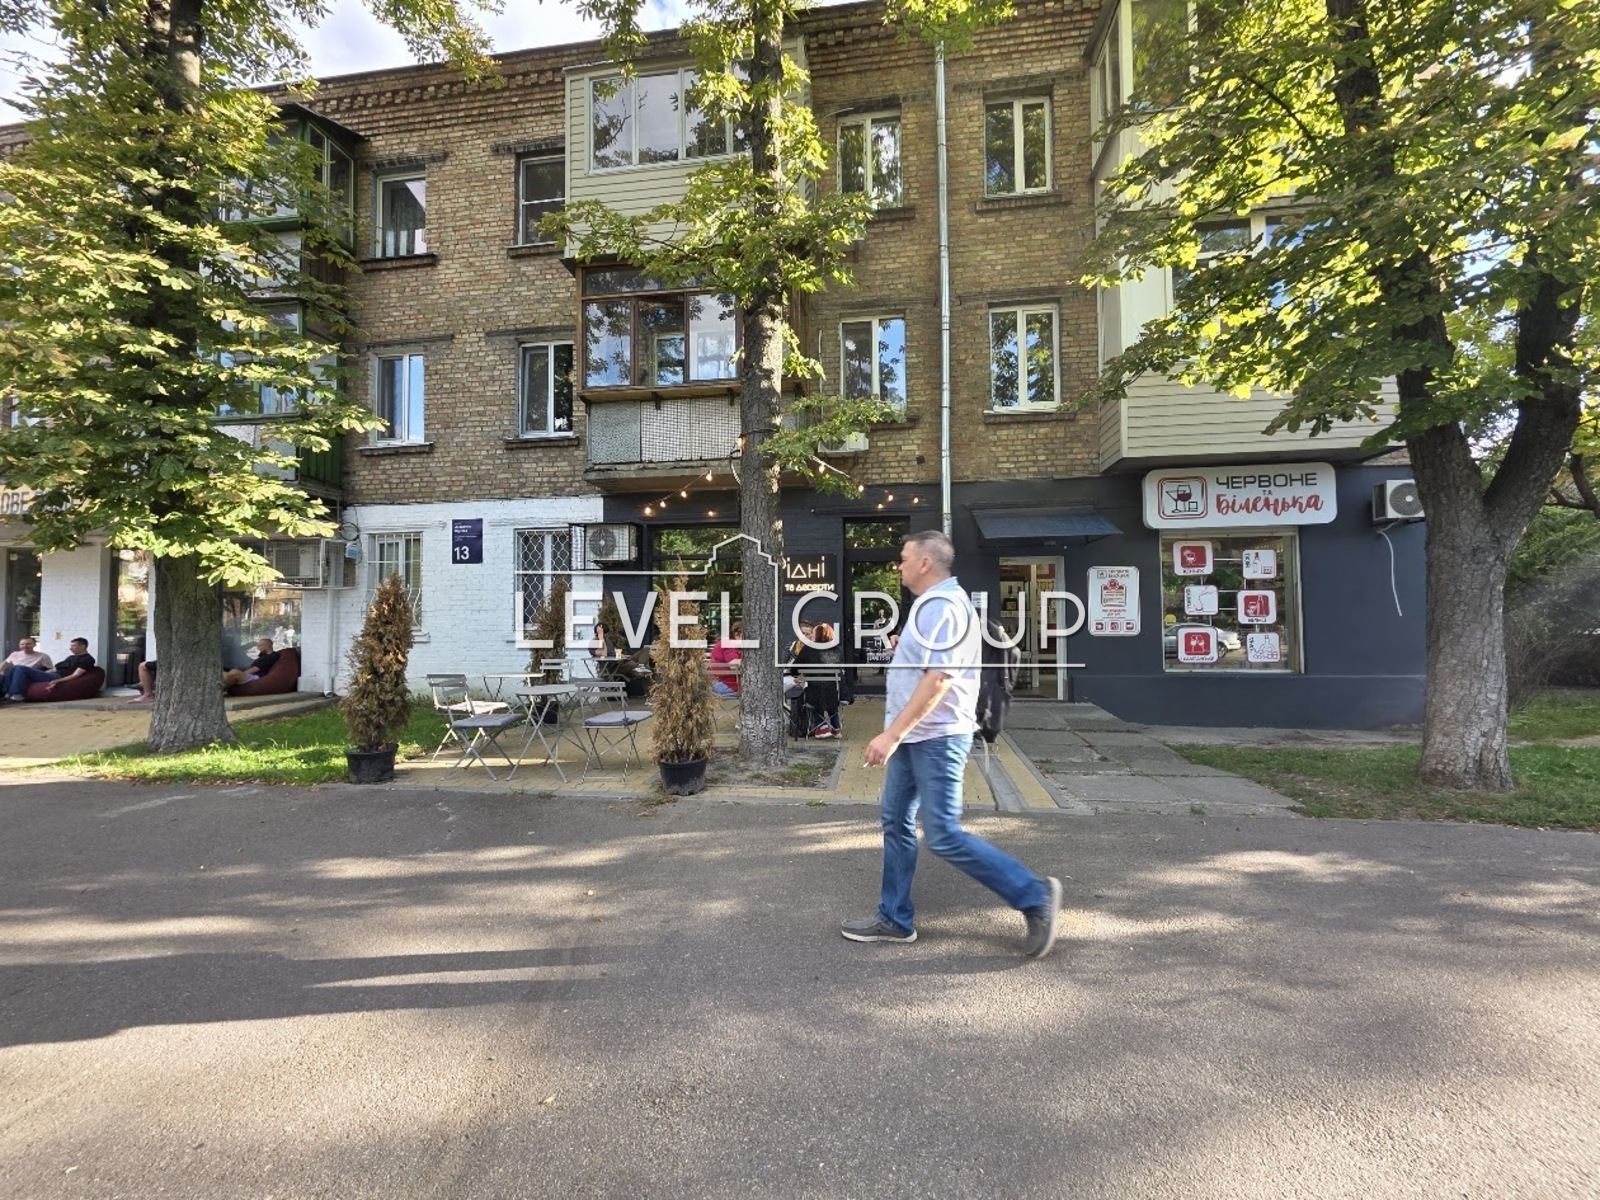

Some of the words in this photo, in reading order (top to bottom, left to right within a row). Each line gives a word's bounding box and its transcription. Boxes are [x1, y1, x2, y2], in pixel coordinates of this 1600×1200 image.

[1215, 472, 1318, 490] ЧЕРВОНЕ
[1215, 493, 1324, 516] Біленька
[454, 546, 470, 560] 13
[782, 556, 826, 579] ідні
